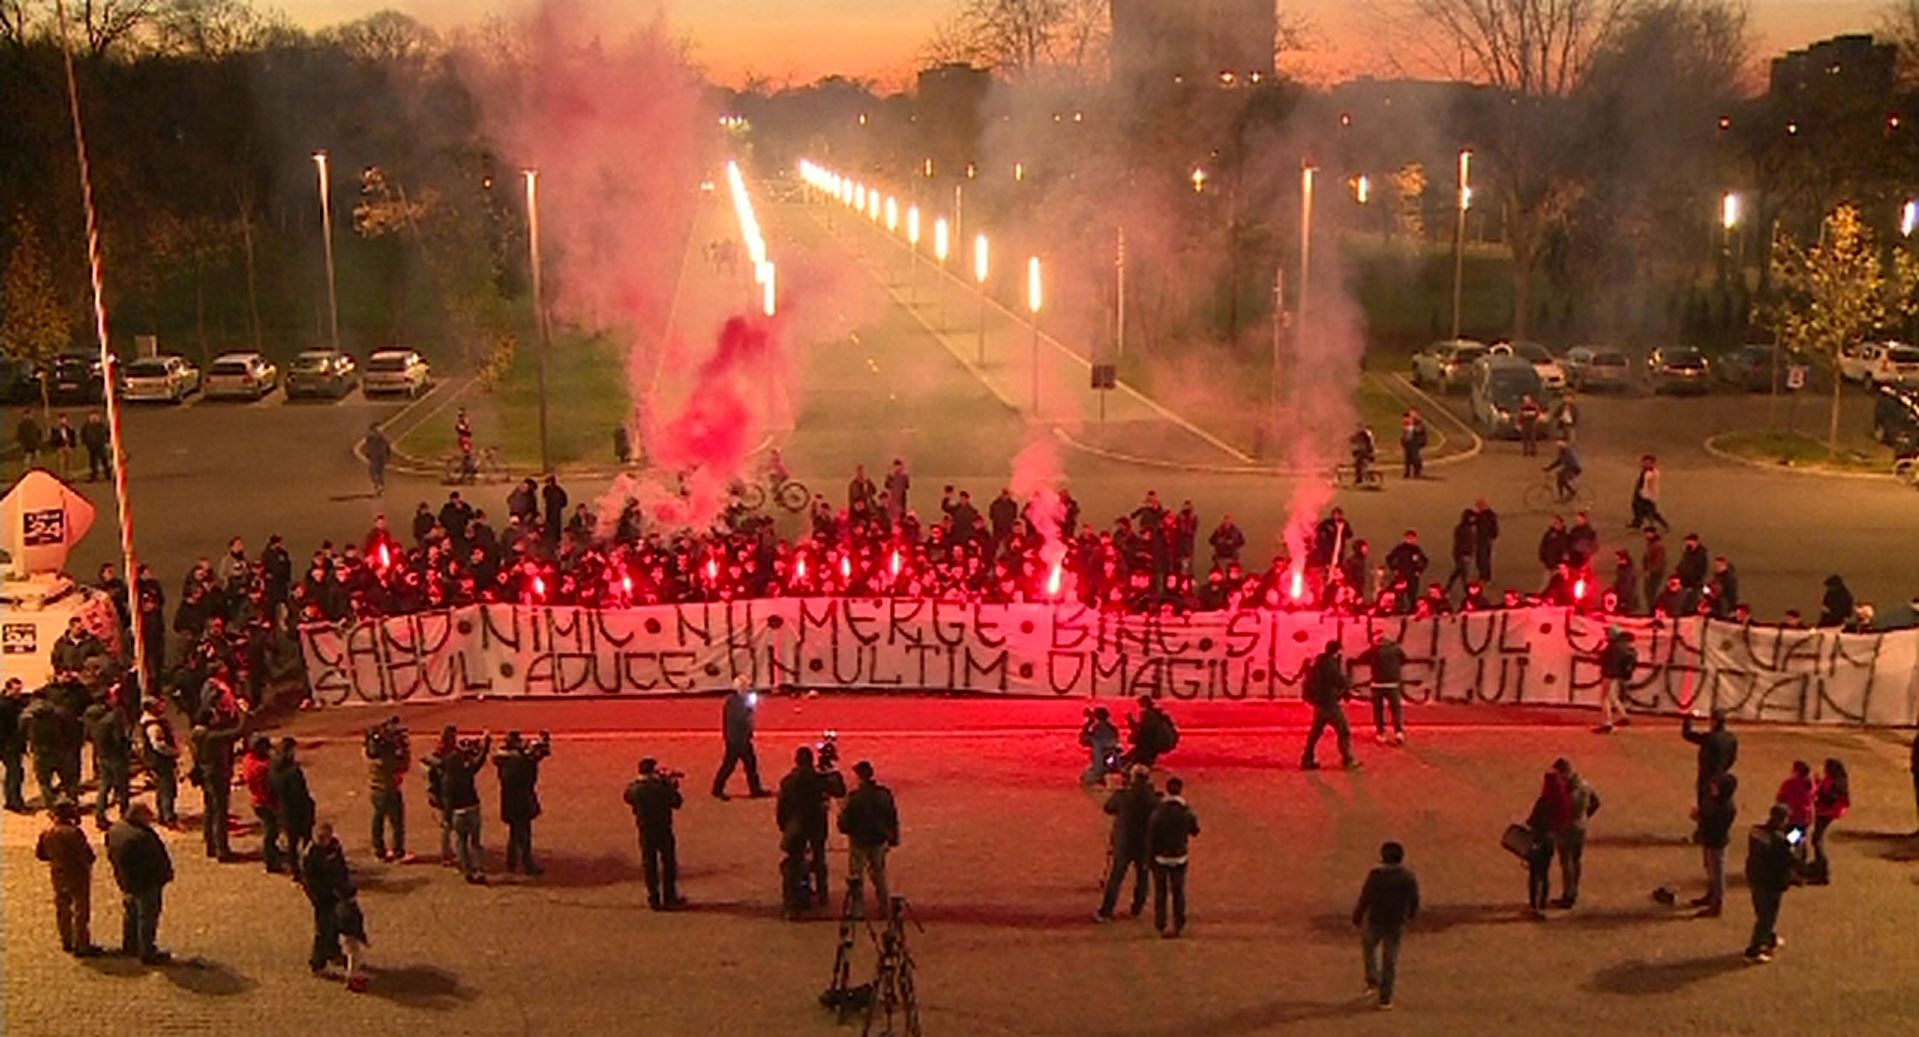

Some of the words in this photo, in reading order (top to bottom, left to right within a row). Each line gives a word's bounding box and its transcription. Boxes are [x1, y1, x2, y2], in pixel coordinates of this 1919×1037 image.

[481, 606, 634, 652] NIMIC
[799, 599, 1006, 646] MERGE
[526, 652, 697, 693] ADUCE
[833, 645, 1009, 691] ULTIM
